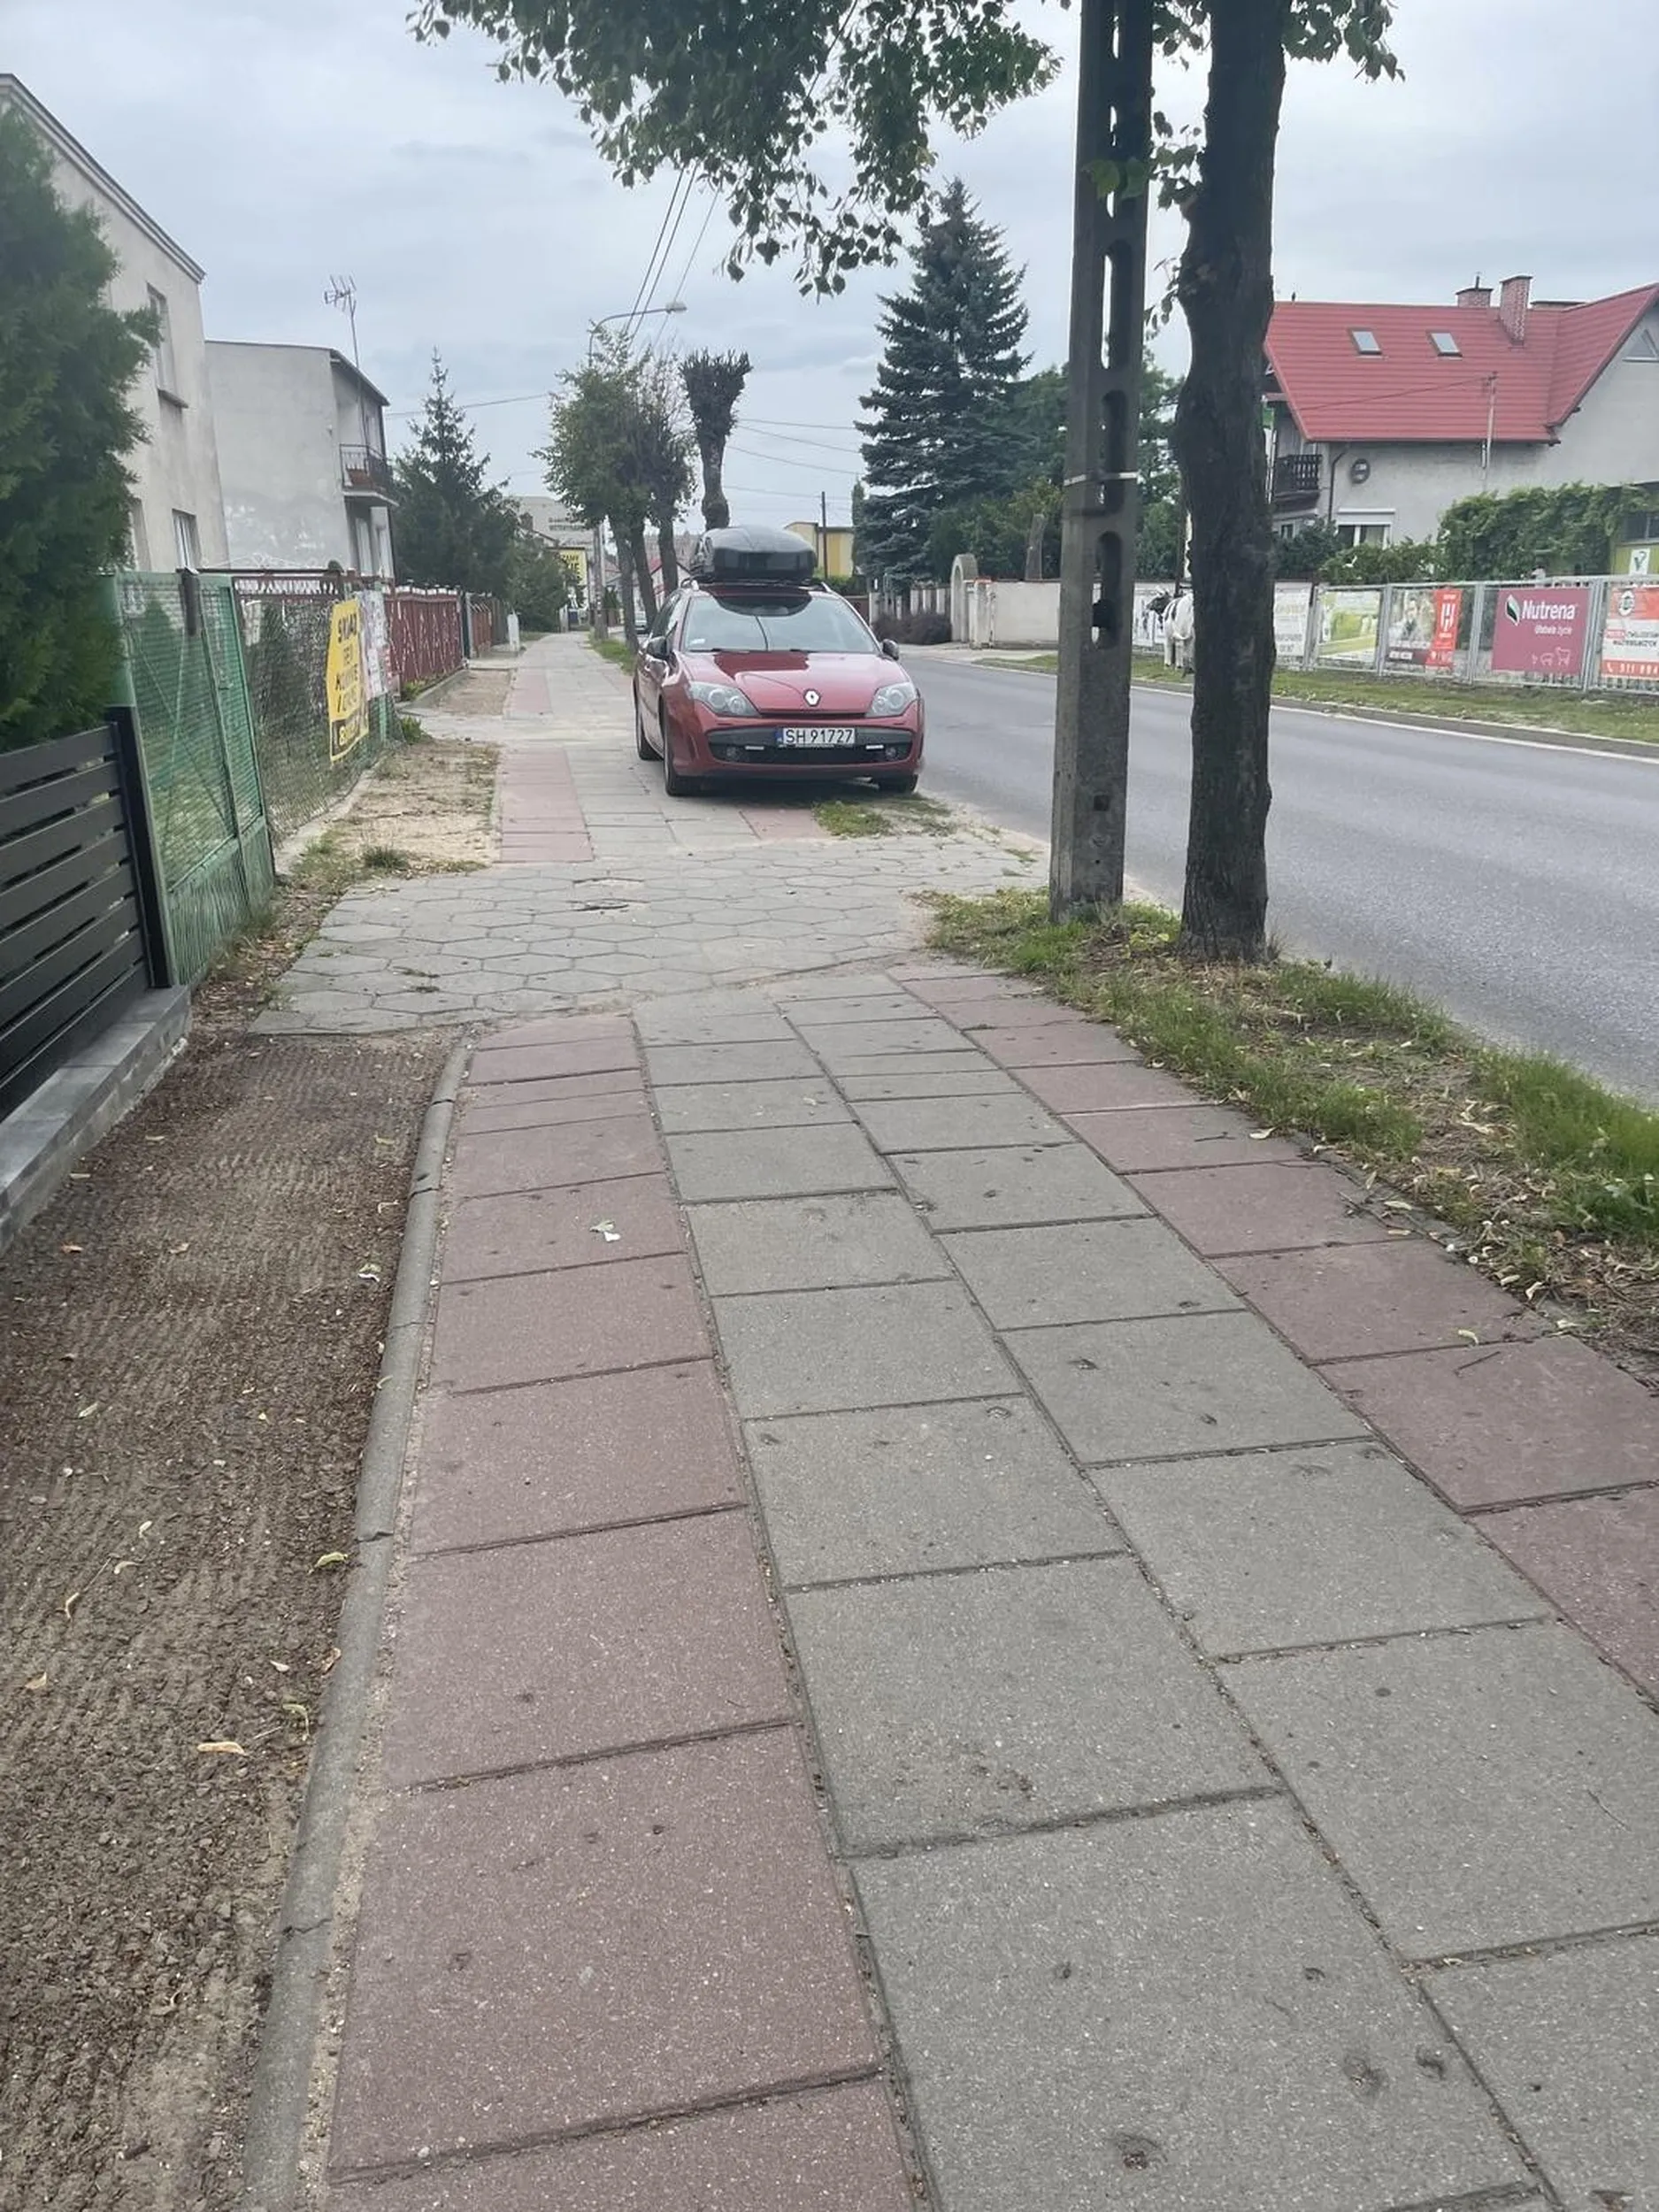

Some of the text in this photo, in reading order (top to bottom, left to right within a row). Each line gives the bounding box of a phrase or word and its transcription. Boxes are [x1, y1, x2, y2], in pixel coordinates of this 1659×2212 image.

[1521, 599, 1575, 620] Nutrena
[786, 729, 853, 742] SH 91727
